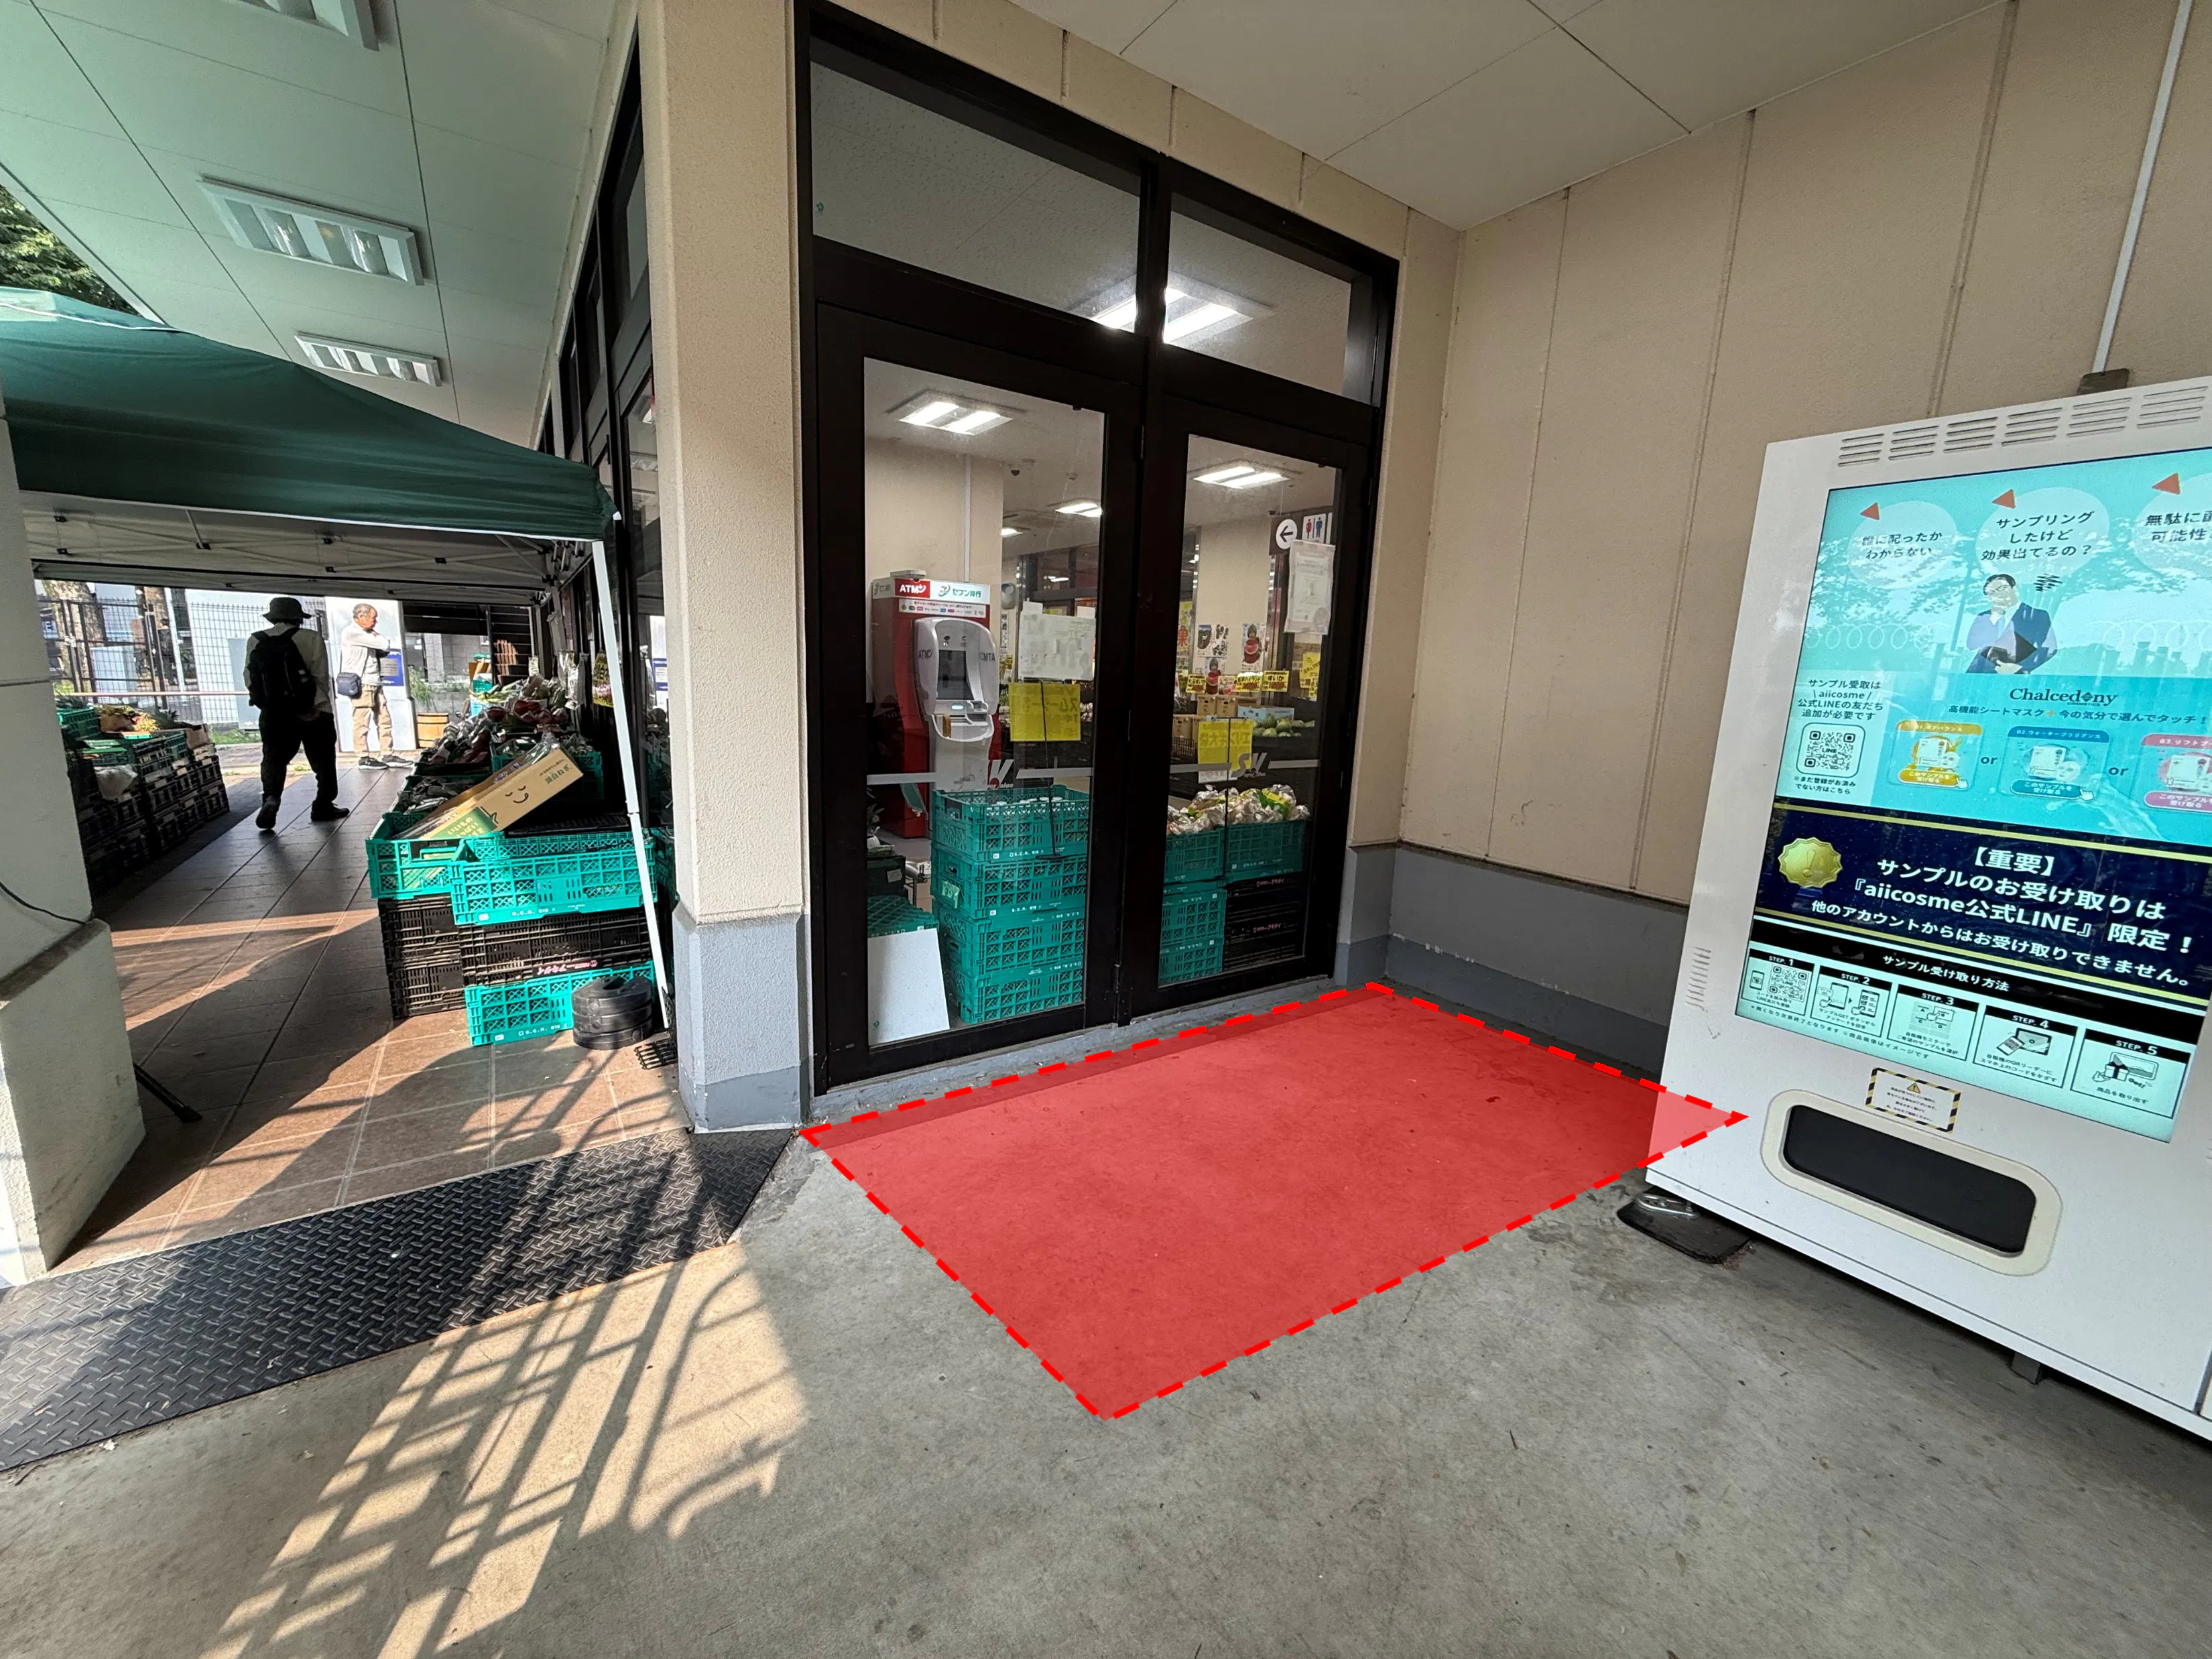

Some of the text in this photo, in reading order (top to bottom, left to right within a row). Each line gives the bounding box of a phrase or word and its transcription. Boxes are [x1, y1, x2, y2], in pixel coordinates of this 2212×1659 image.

[1996, 511, 2094, 529] サンプリング
[1862, 531, 1943, 547] 誰に配ったか
[2010, 529, 2073, 544] したけど
[2152, 528, 2212, 543] 可能性
[1865, 548, 1932, 560] わからない
[900, 585, 921, 593] ATM
[953, 589, 981, 597] セブン銀行
[1808, 680, 1881, 690] サンプル受取は
[1819, 690, 1865, 699] aiicosme
[1798, 700, 1884, 711] 公式LINEの友だち
[1801, 709, 1876, 721] 追加が必要です
[1949, 705, 2206, 725] 高機能シートマスク 今の気分で選んでタッチ！
[1981, 756, 1998, 765] or
[2109, 767, 2128, 776] or
[1796, 784, 1851, 794] でない方はこちら
[2024, 782, 2072, 791] このサンプルを
[1975, 847, 2055, 877] 【重要】
[1877, 858, 2166, 921] サンプルのお受け取りは
[1811, 900, 2189, 987] 他のアカウントからはお受け取りできません。
[1768, 955, 1786, 964] STEP.
[1841, 973, 1870, 985] STEP. 2
[1883, 955, 2010, 991] サンプル受け取り方法
[1922, 992, 1955, 1005] STEP. 3
[2012, 1014, 2050, 1029] STEP. 4
[2115, 1040, 2158, 1056] STEP. 5
